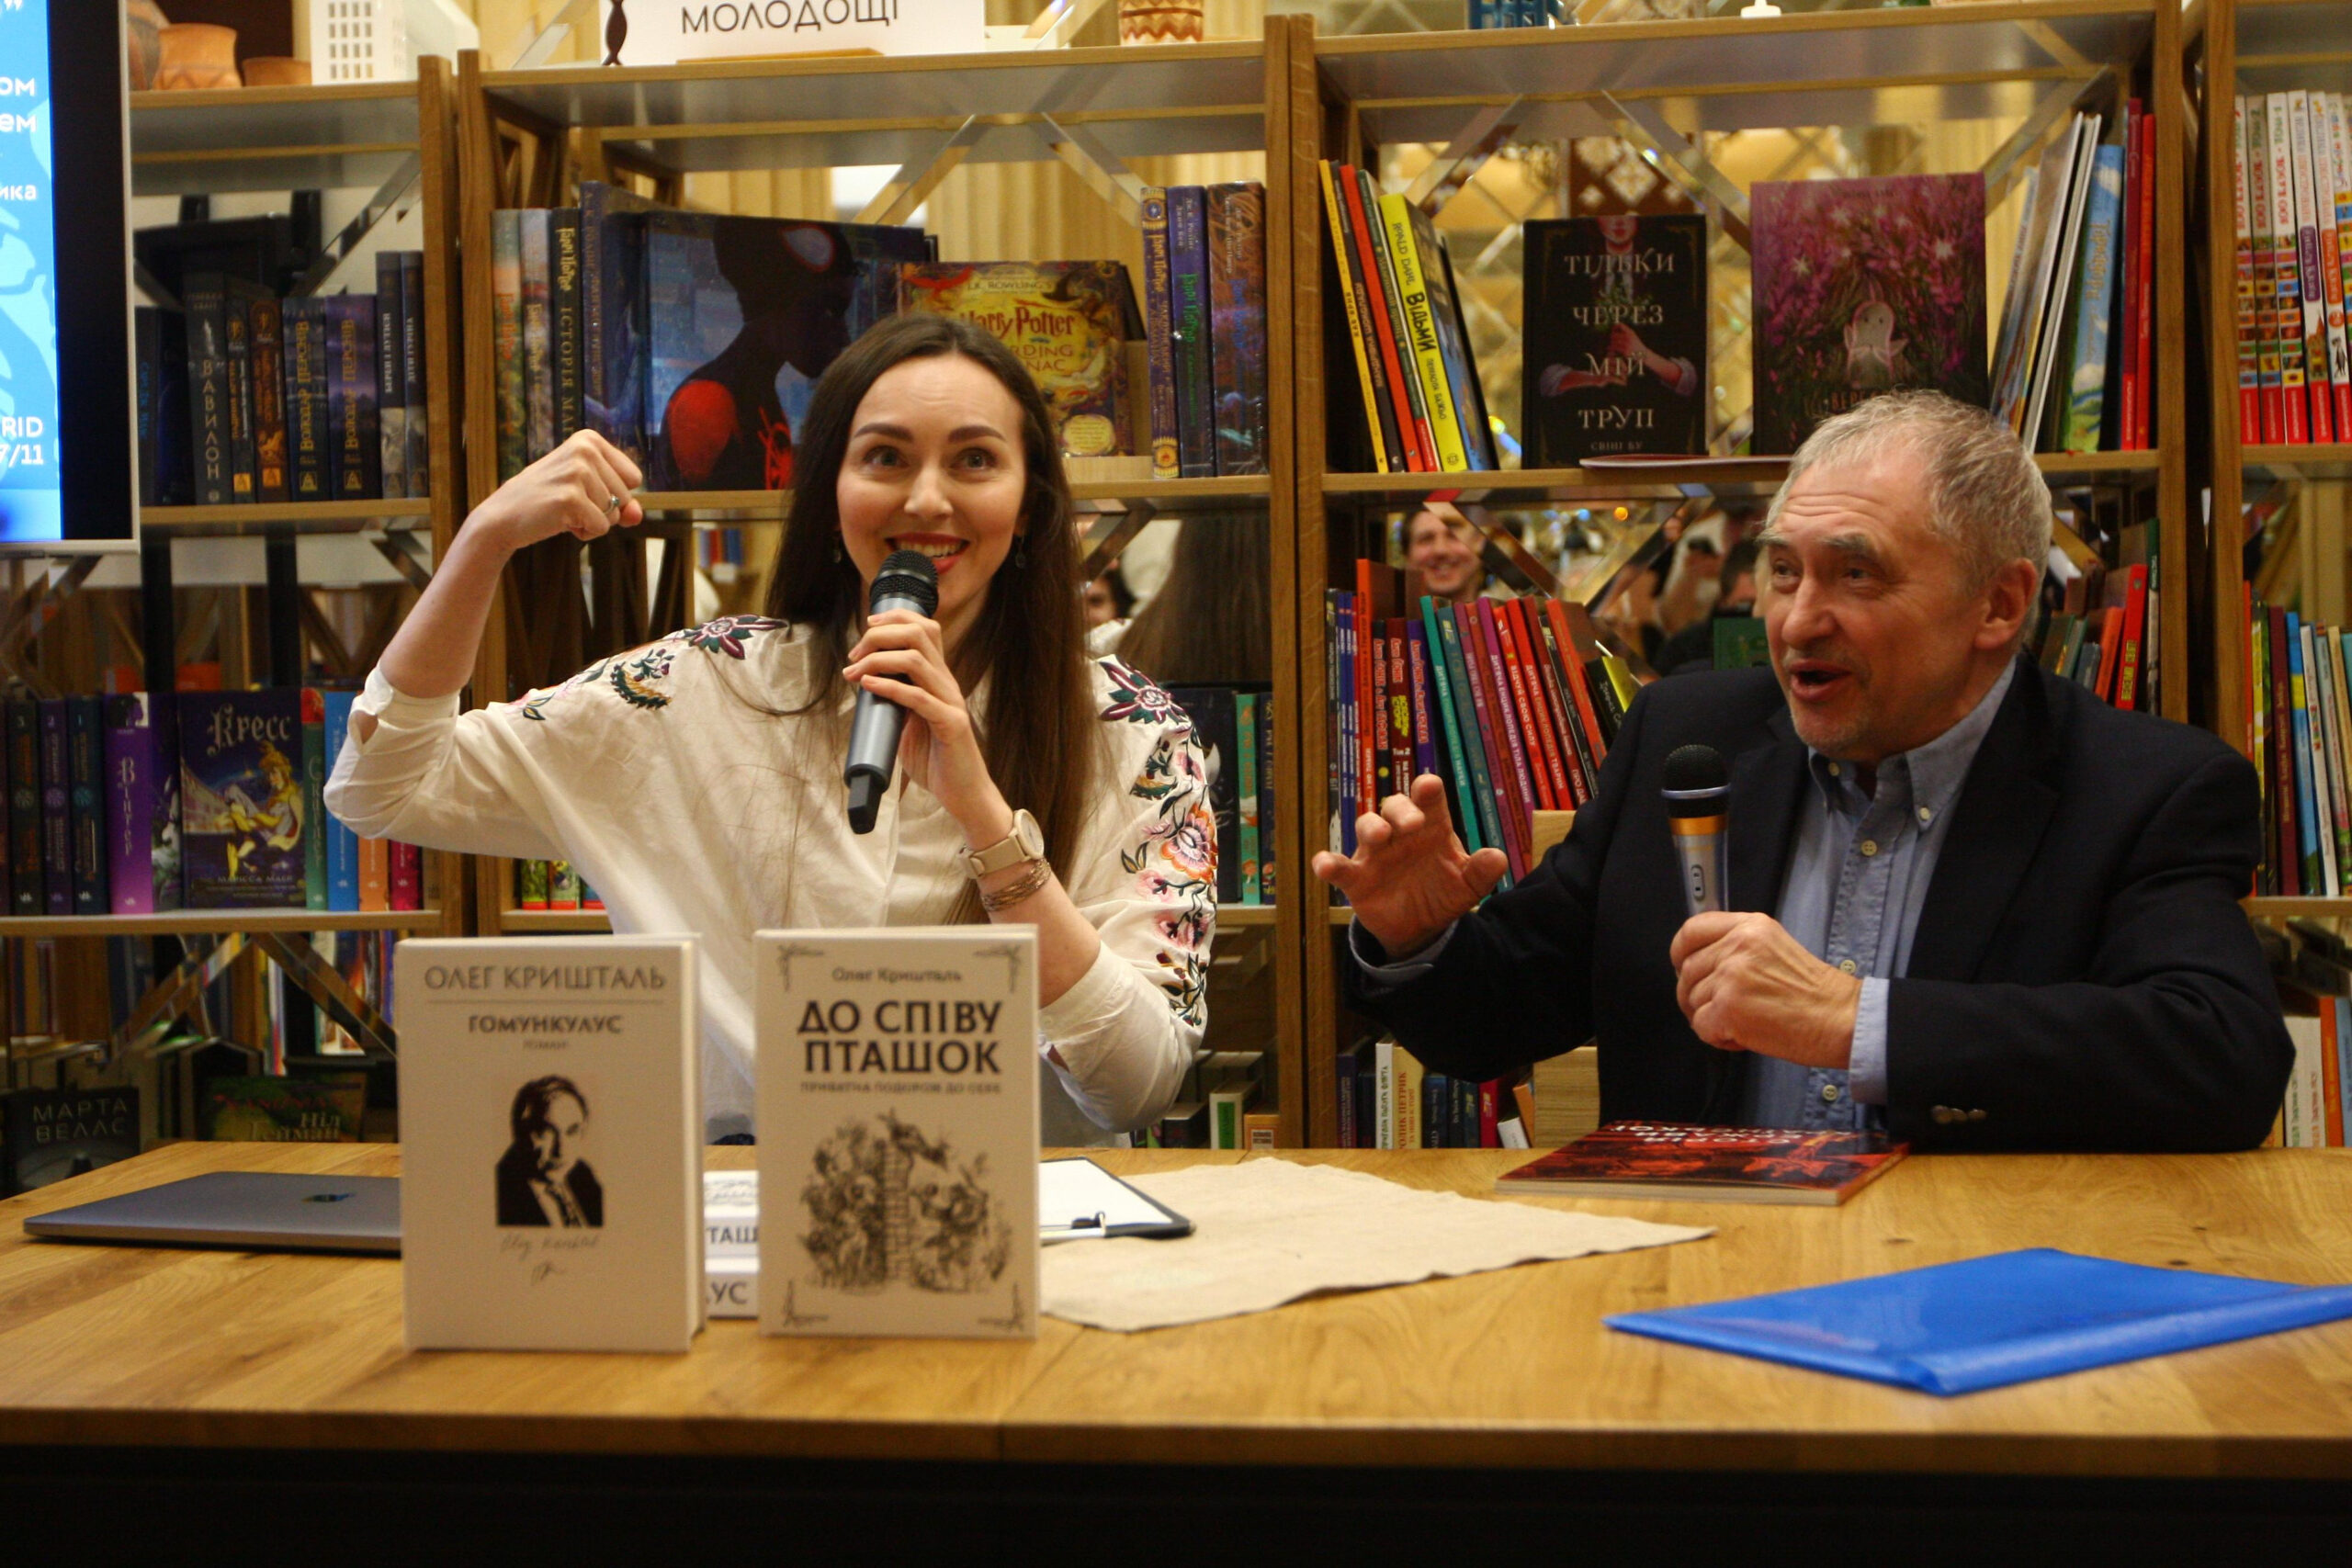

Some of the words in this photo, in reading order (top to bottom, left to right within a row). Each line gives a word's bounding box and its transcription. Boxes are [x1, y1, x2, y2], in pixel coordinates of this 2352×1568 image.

[682, 0, 898, 34] МОЛОДОЩІ
[1391, 221, 1409, 255] ROALD
[1399, 257, 1417, 286] DAHL
[1564, 247, 1675, 278] ТІЛЬКИ
[1014, 307, 1076, 340] Potter
[1400, 290, 1442, 354] ВІДЬМИ
[1572, 304, 1664, 325] ЧЕРЕЗ
[560, 306, 573, 387] ІСТОРІЯ
[1585, 352, 1645, 376] МІЙ
[1577, 405, 1655, 430] ТРУП
[1434, 664, 1448, 696] ДИТЯЧА
[1490, 653, 1504, 685] ДИТЯЧА
[1524, 663, 1540, 695] ДИТЯЧА
[1498, 686, 1518, 748] ЕНЦИКЛОПЕДІЯ
[1509, 664, 1524, 695] ВІДЧУЙ
[1517, 696, 1531, 722] СВОЮ
[1524, 723, 1537, 746] СИЛУ
[1404, 748, 1411, 756] 2
[1512, 749, 1522, 767] ТІЛА
[1516, 767, 1531, 803] ЛЮДИНИ
[1571, 768, 1582, 787] ПРО
[424, 965, 497, 991] ОЛЕГ
[503, 965, 666, 991] КРИШТАЛЬ
[831, 967, 872, 982] Олег
[877, 967, 962, 984] Кришталь
[469, 1015, 622, 1033] ГОМУНКУЛУС
[797, 1001, 861, 1035] ДО
[874, 1000, 1002, 1034] СПІВУ
[804, 1041, 1001, 1074] ПТАШОК
[32, 1098, 128, 1122] МАРТА
[705, 1225, 759, 1244] ТАШ
[705, 1280, 749, 1304] УС
